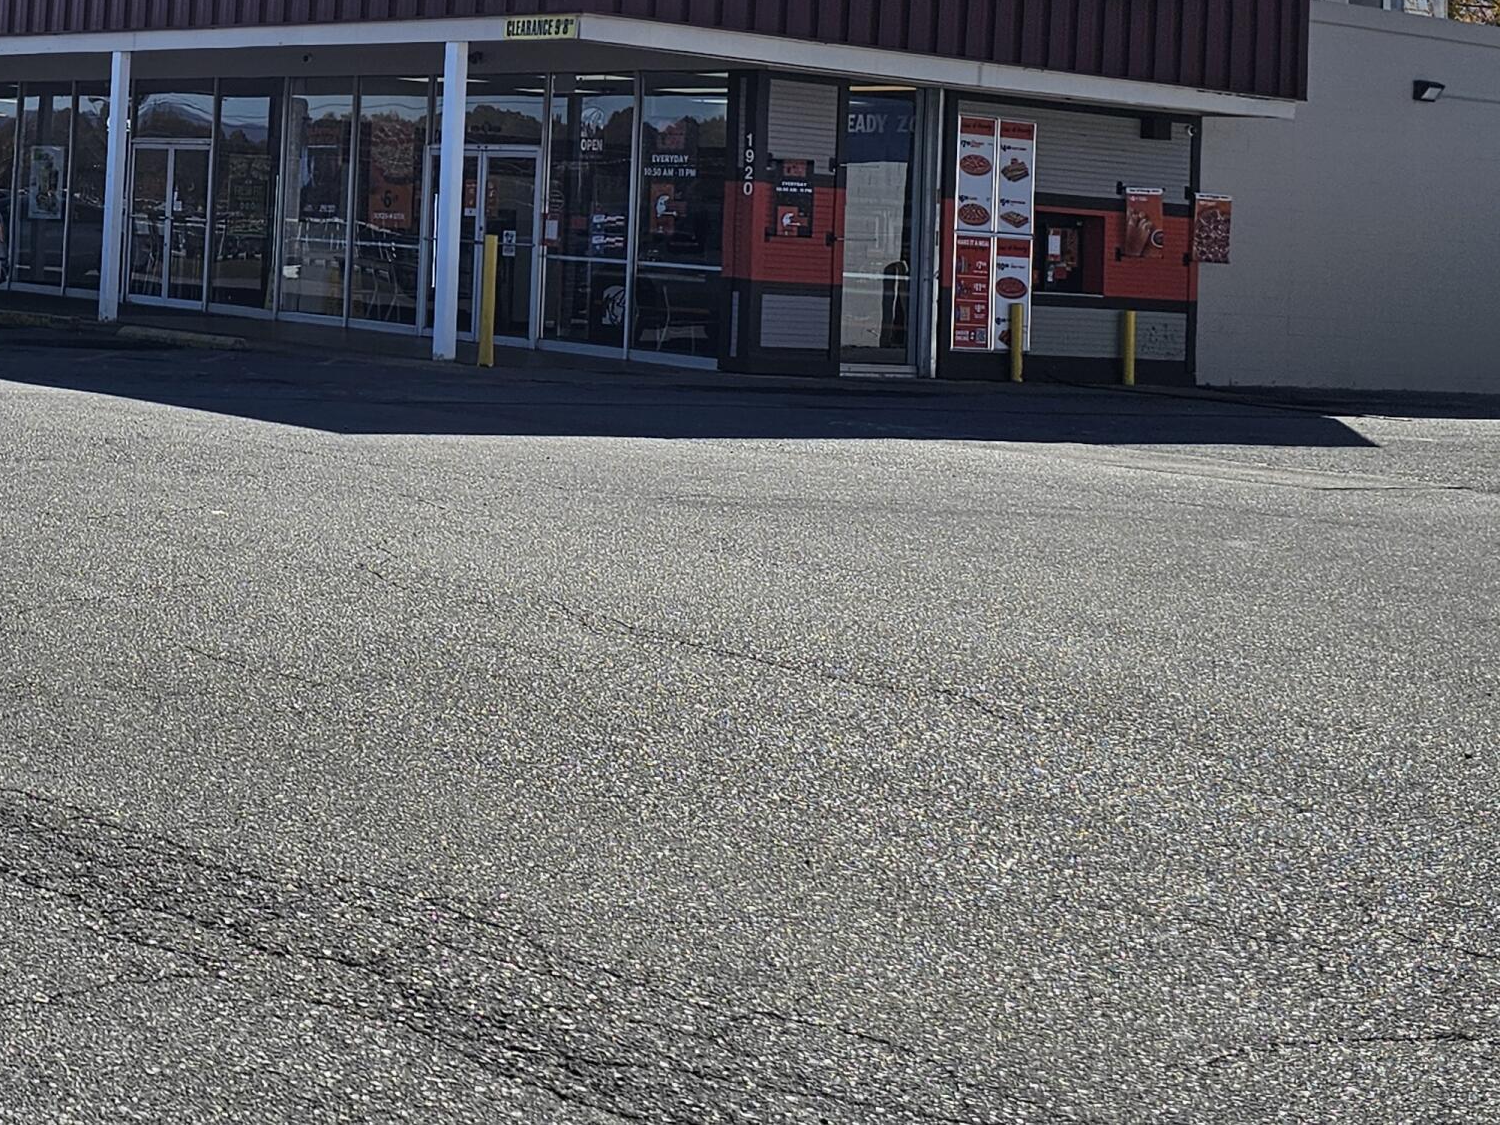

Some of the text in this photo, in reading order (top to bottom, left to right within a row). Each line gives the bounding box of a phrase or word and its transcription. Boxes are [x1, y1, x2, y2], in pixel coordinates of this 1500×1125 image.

[507, 19, 553, 37] CLEARANCE
[847, 114, 887, 134] EADY
[580, 139, 603, 152] OPEN
[651, 154, 689, 164] EVERYDAY
[743, 133, 754, 197] 1920
[685, 168, 697, 177] PM
